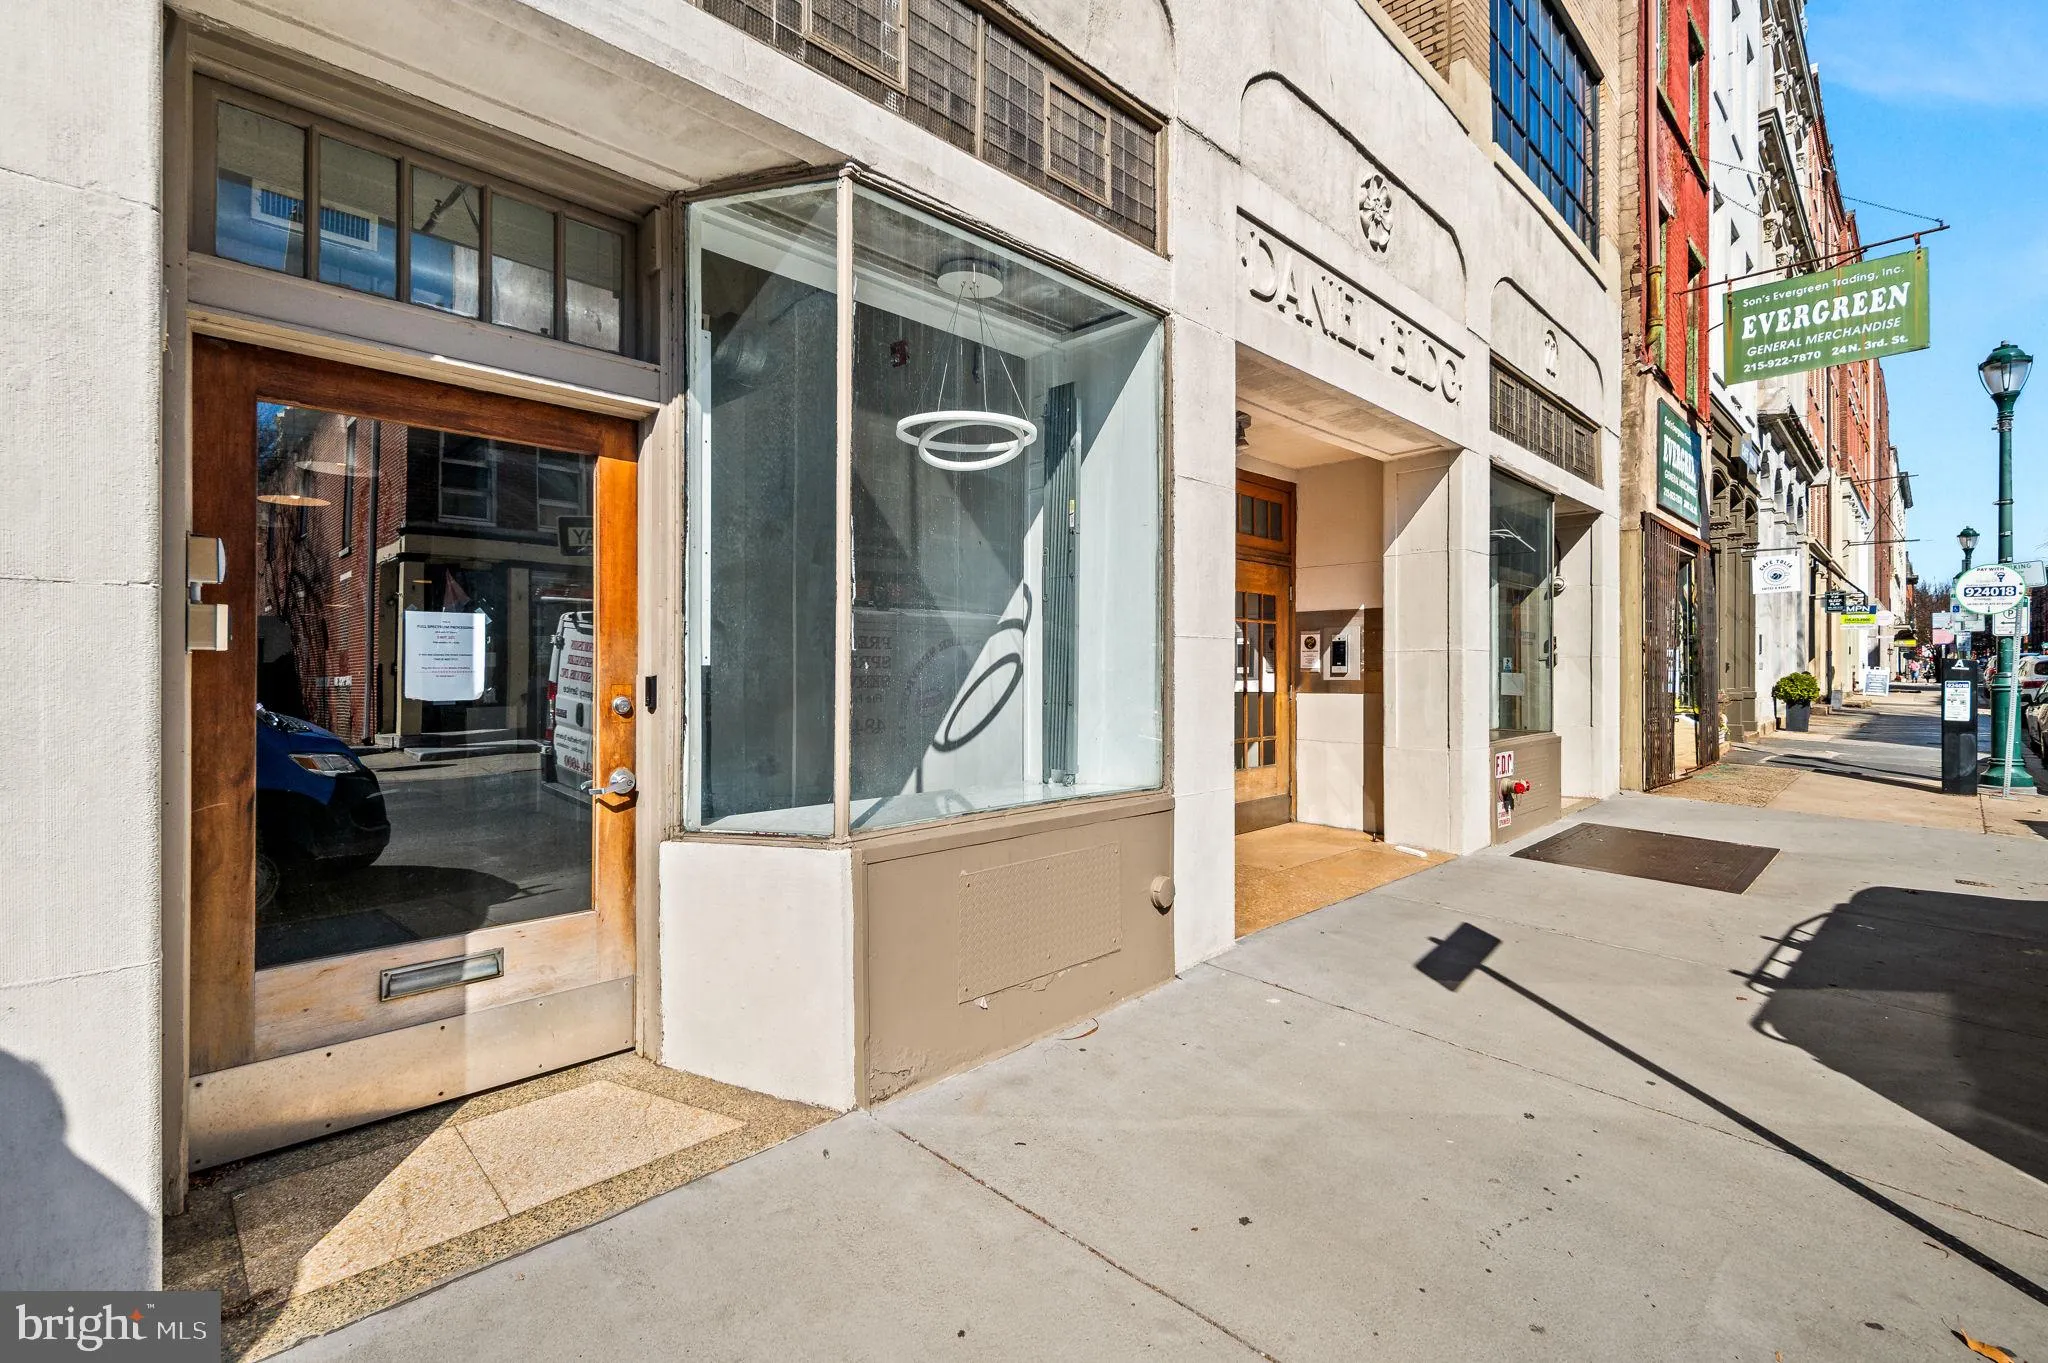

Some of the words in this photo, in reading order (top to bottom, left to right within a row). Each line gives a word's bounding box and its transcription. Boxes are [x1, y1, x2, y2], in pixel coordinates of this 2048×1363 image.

[1249, 229, 1375, 361] DANIEL
[1742, 293, 1770, 308] Son's
[1773, 282, 1829, 302] Evergreen
[1831, 271, 1879, 287] Trading,
[1882, 264, 1905, 277] Inc.
[1741, 281, 1911, 340] EVERGREEN
[1743, 350, 1821, 373] 215-922-7870
[1864, 339, 1888, 350] 3rd.
[1891, 335, 1909, 346] St.
[1747, 338, 1802, 357] GENERAL
[1805, 317, 1901, 344] MERCHANDISE
[1759, 560, 1774, 571] CAFE
[1965, 586, 2015, 597] 924018
